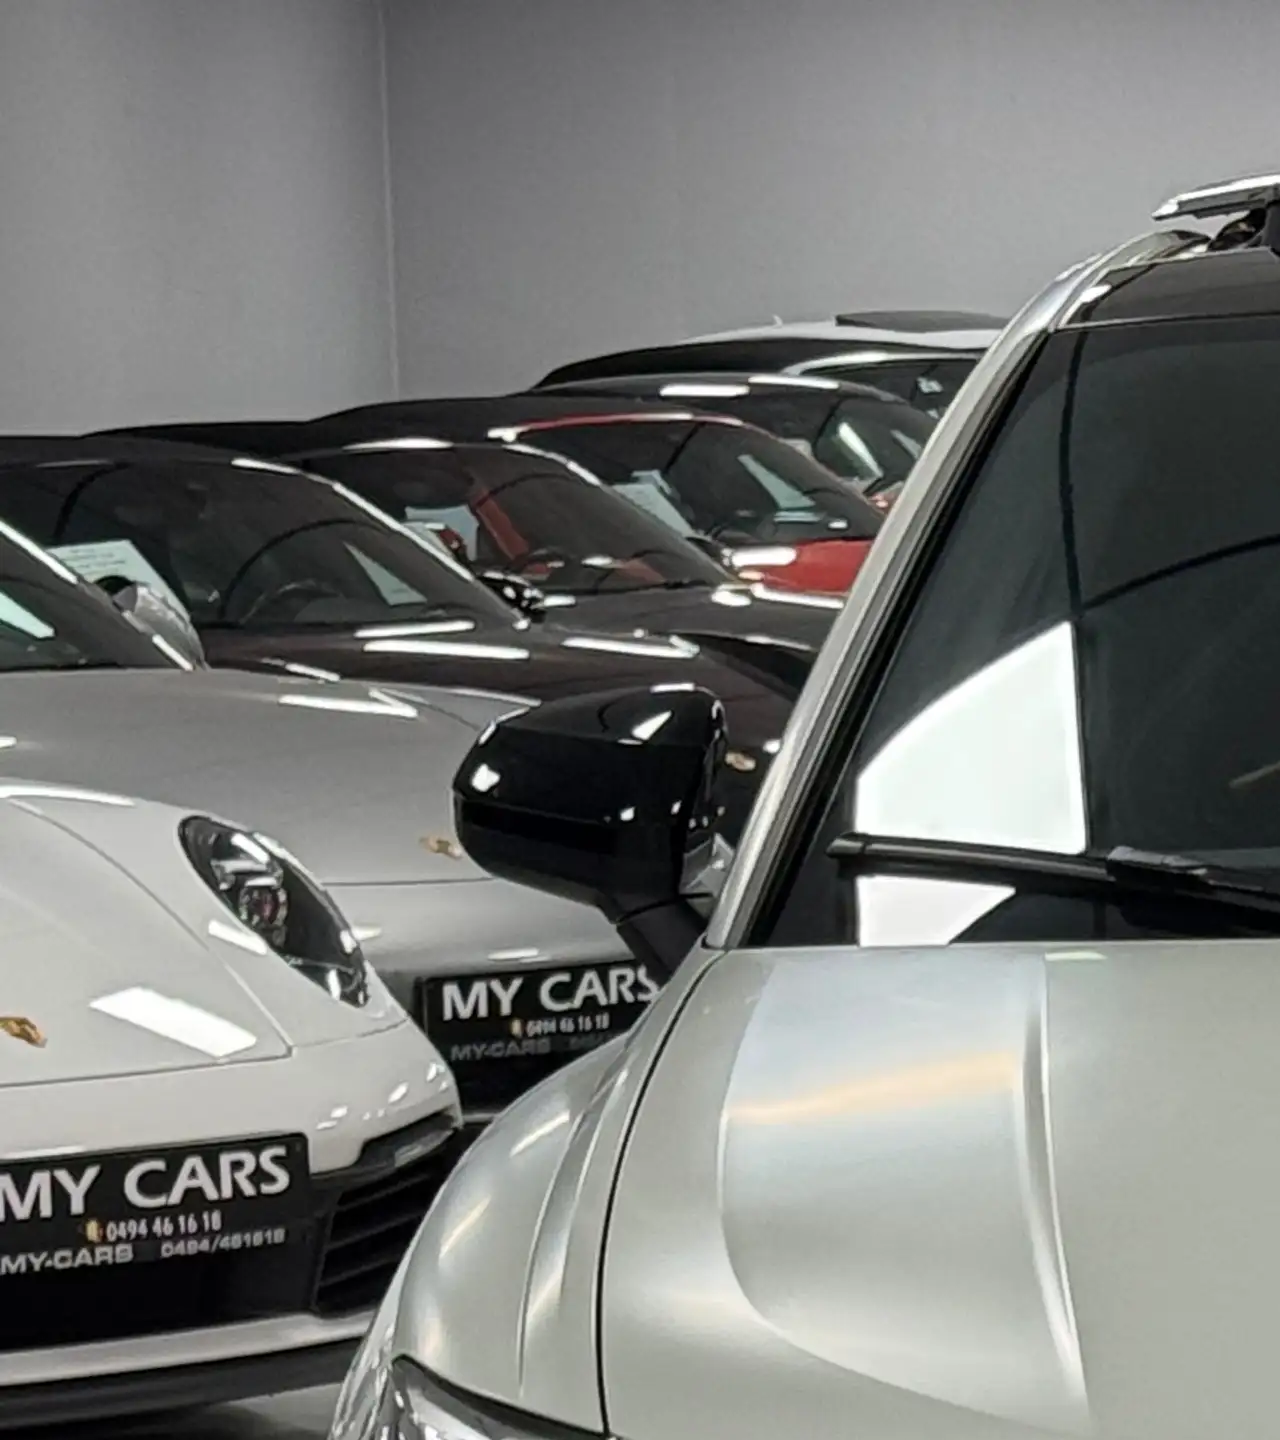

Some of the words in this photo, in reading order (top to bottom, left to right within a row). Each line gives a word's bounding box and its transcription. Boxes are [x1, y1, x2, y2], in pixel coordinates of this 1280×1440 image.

[442, 977, 523, 1021] MY
[540, 965, 661, 1012] CARS
[0, 1165, 101, 1222] MY
[124, 1145, 290, 1208] CARS
[106, 1219, 148, 1242] 0494
[152, 1216, 174, 1238] 46
[178, 1213, 198, 1234] 16
[202, 1209, 222, 1232] 18
[0, 1243, 134, 1275] MY-CARS
